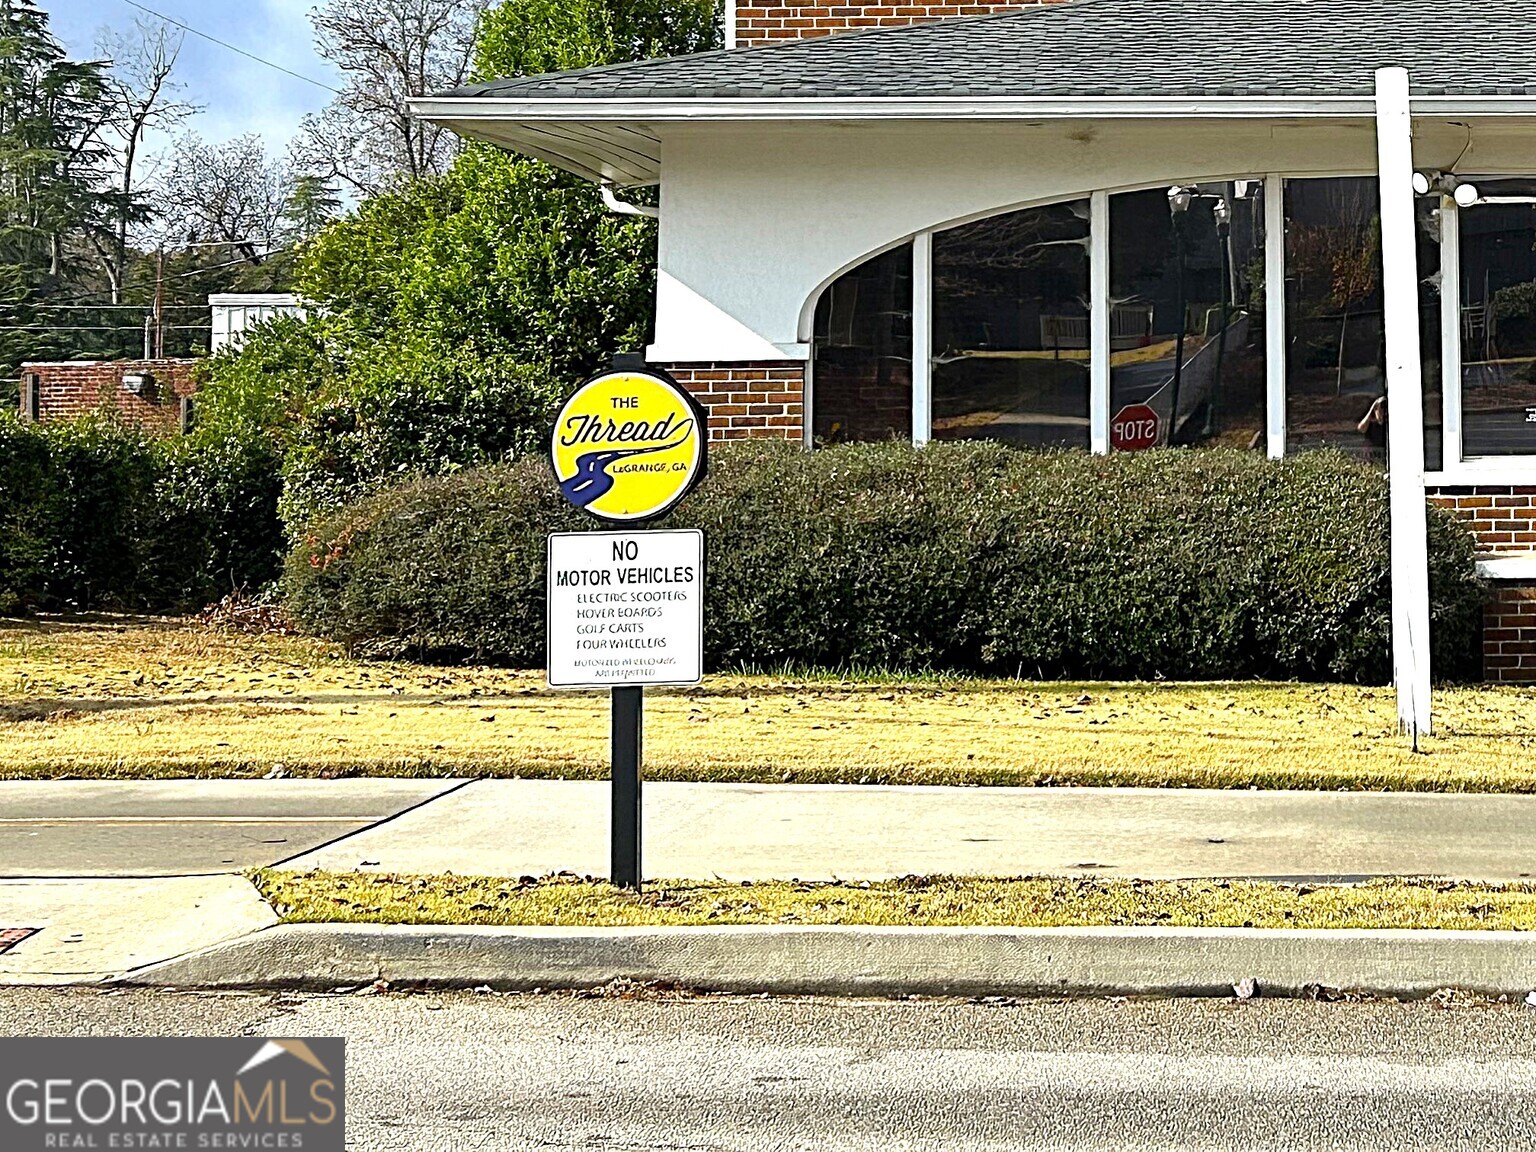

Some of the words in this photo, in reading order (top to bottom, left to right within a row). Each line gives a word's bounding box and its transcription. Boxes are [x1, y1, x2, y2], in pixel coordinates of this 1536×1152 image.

[610, 397, 639, 408] THE
[561, 412, 684, 446] Thread
[672, 462, 687, 471] GA
[612, 540, 639, 561] NO
[557, 569, 611, 586] MOTOR
[617, 566, 694, 584] VEHICLES
[577, 592, 628, 603] ELECTRIC
[630, 591, 687, 602] SCOOTERS
[577, 608, 615, 618] HOVER
[618, 607, 663, 617] BOARDS
[576, 624, 606, 634] GOLF
[609, 623, 644, 633] CARTS
